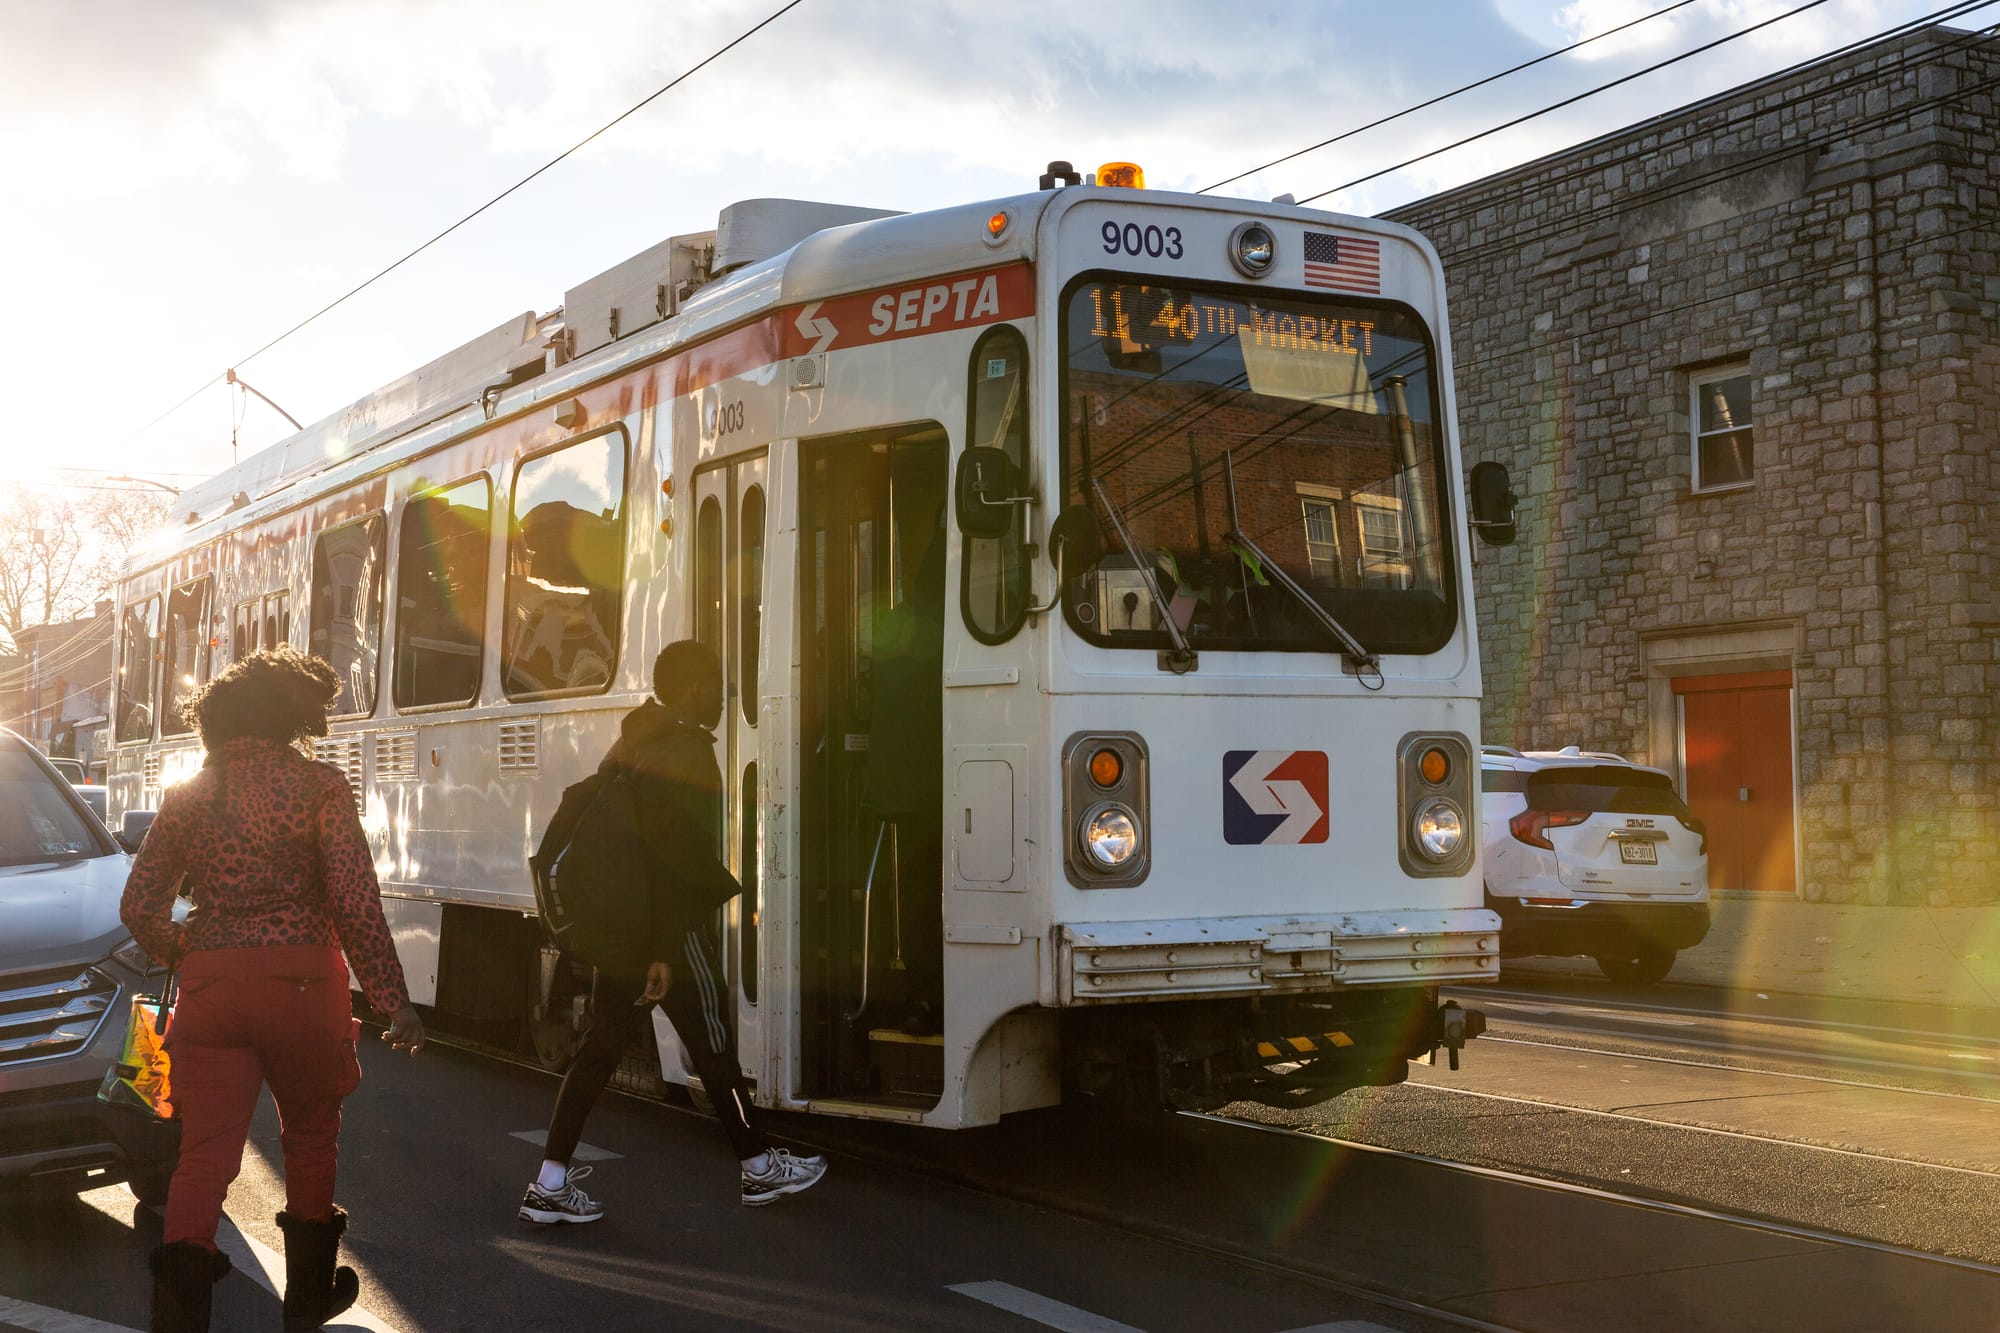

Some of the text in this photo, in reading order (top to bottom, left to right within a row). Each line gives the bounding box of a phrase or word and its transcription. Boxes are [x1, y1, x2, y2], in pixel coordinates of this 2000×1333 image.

[1101, 220, 1184, 260] 9003
[868, 274, 1000, 336] SEPTA
[1089, 287, 1125, 340] 11
[1626, 819, 1655, 829] GMC
